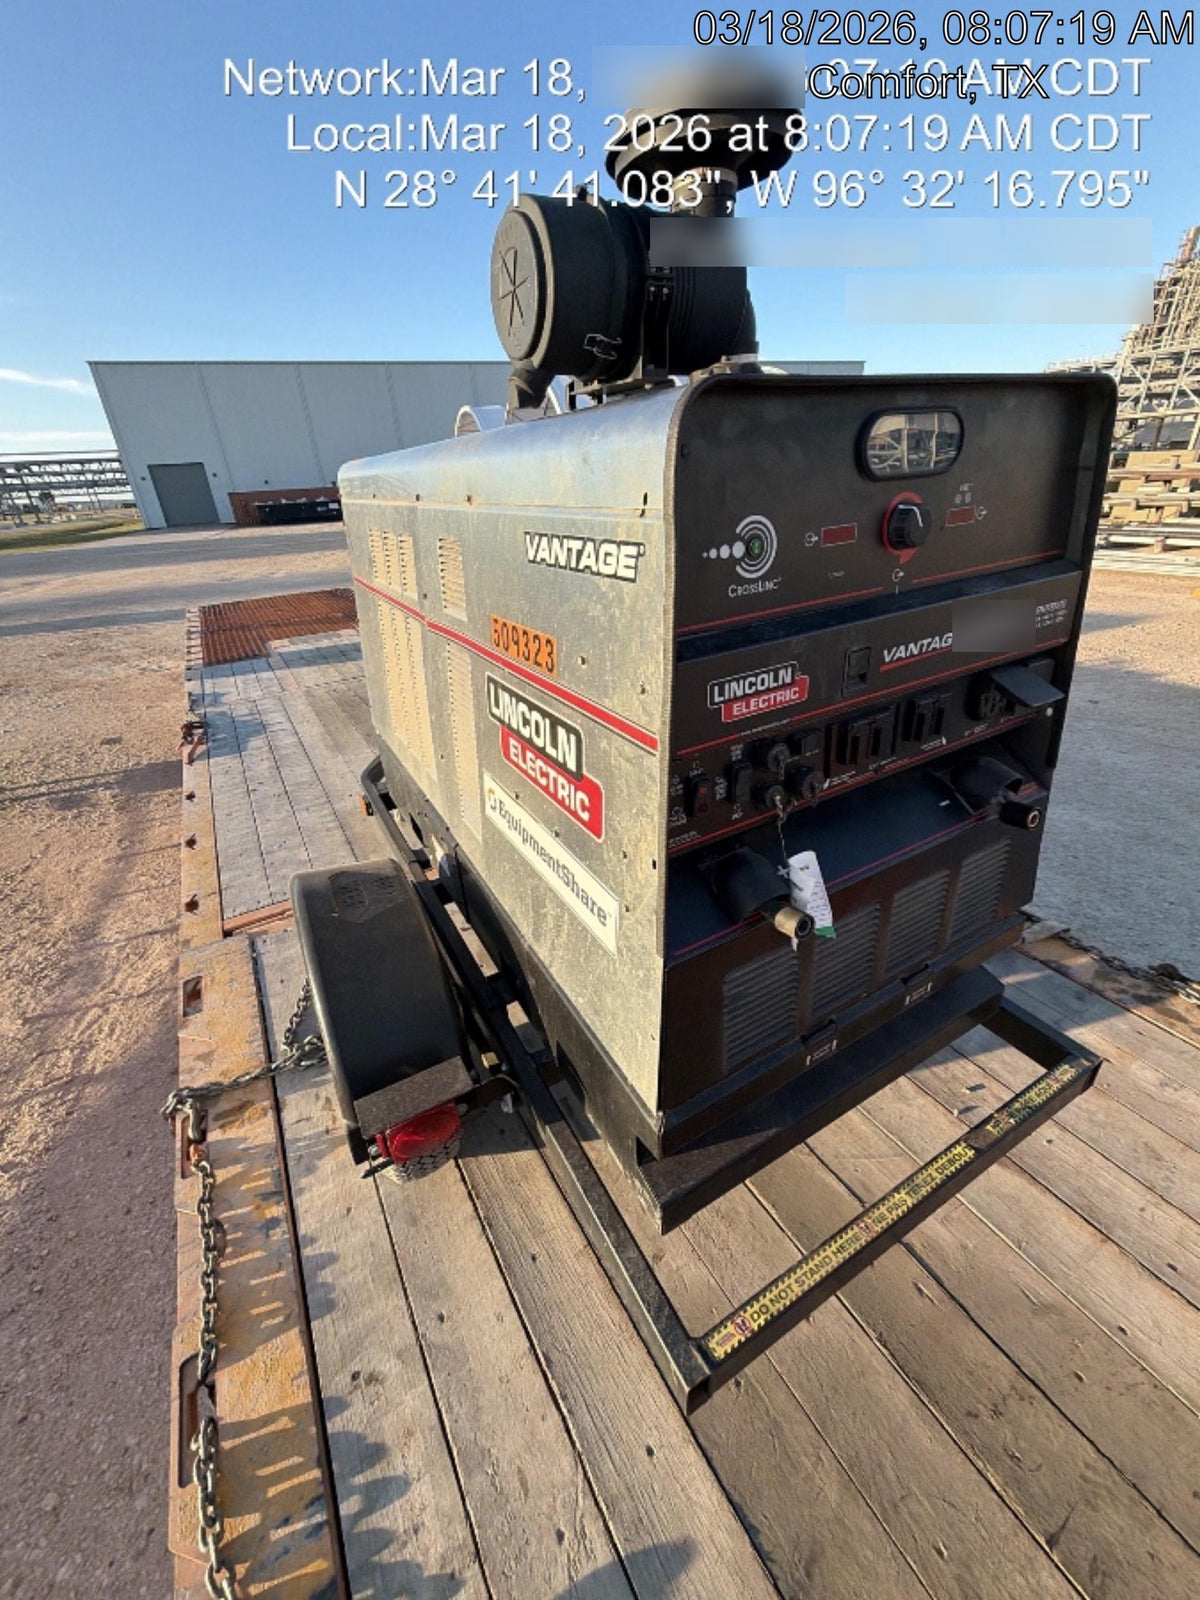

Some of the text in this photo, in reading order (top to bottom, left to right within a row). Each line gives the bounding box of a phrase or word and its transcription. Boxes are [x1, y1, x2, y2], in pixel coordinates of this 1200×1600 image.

[524, 531, 643, 582] VANTAGE
[489, 681, 578, 773] LINCOLN
[714, 666, 792, 703] LINCOLN
[732, 686, 801, 716] ELECTRIC
[508, 736, 591, 822] ELECTRIC
[497, 798, 608, 928] EquipmentShare
[750, 1232, 861, 1323] DO NOT STAND HERE
